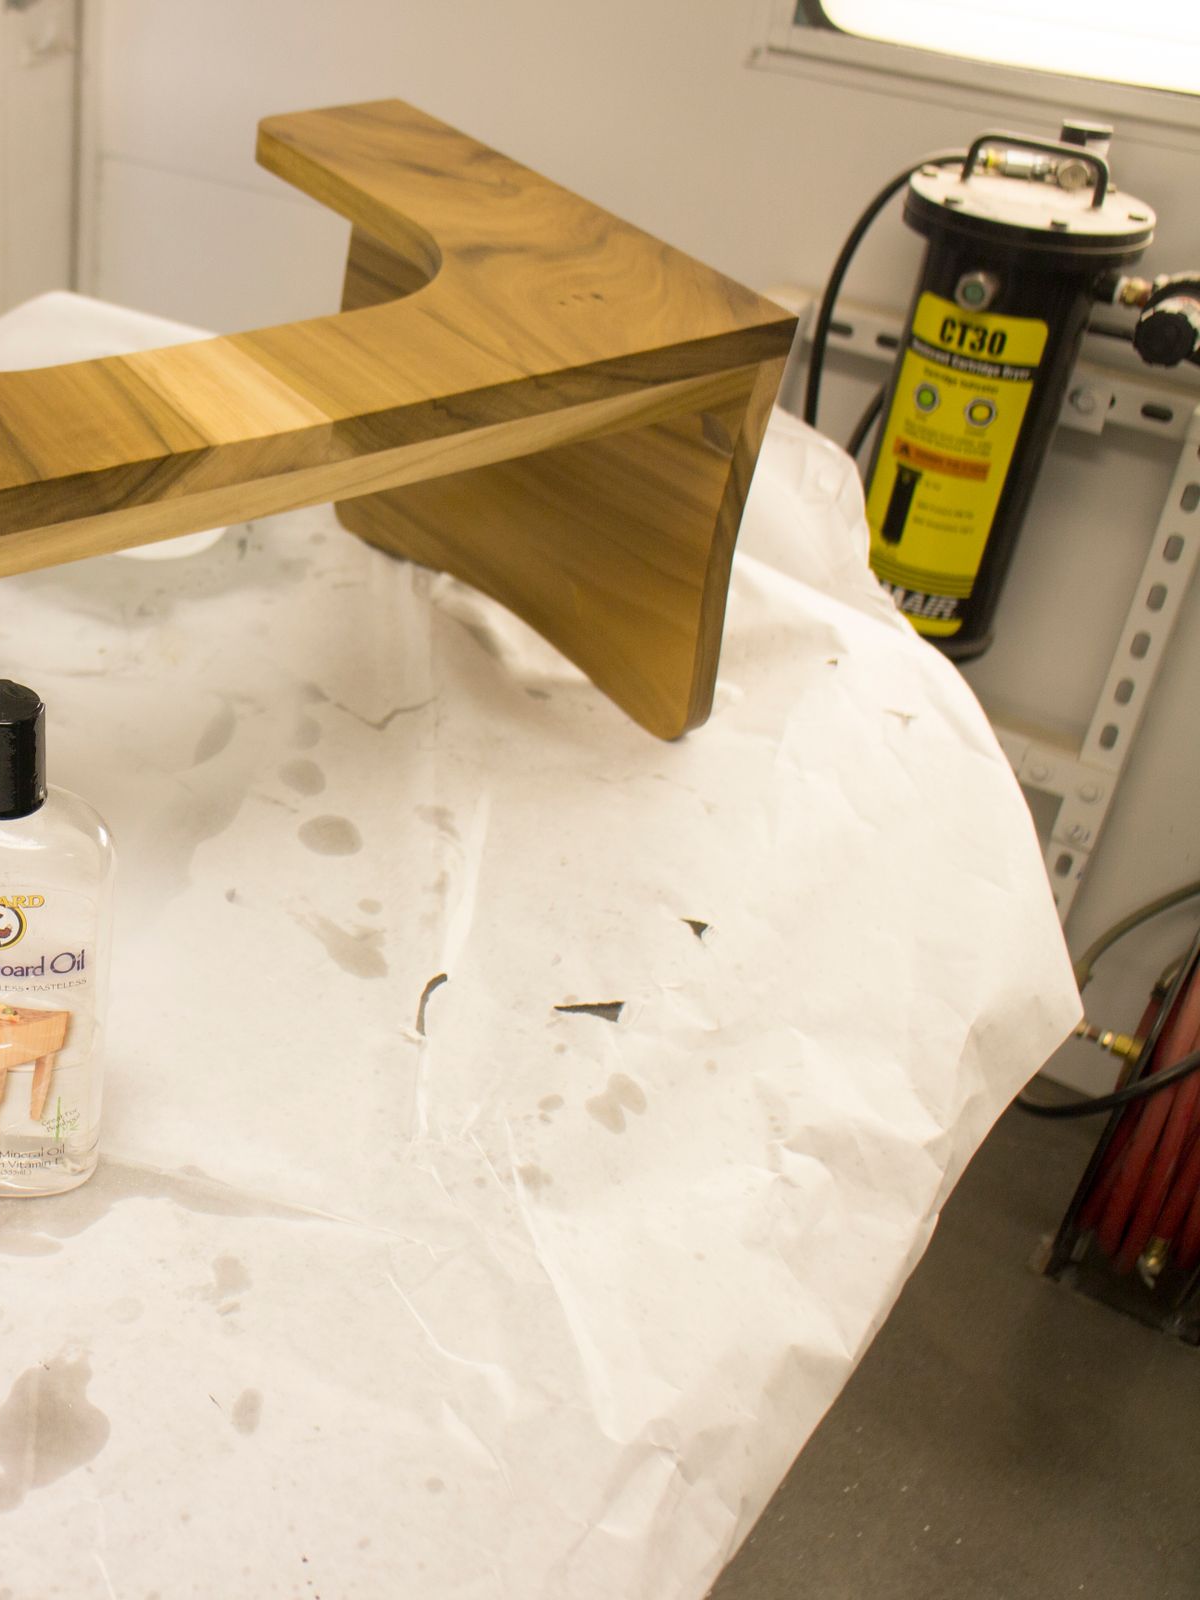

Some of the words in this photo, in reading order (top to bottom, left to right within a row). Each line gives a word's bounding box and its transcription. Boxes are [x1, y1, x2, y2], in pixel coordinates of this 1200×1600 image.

[939, 317, 1007, 355] CT30
[50, 949, 86, 974] Oil
[32, 977, 88, 992] TASTELESS
[0, 1146, 44, 1159] Mineral
[46, 1143, 65, 1156] Oil
[7, 1159, 52, 1169] Vitamin
